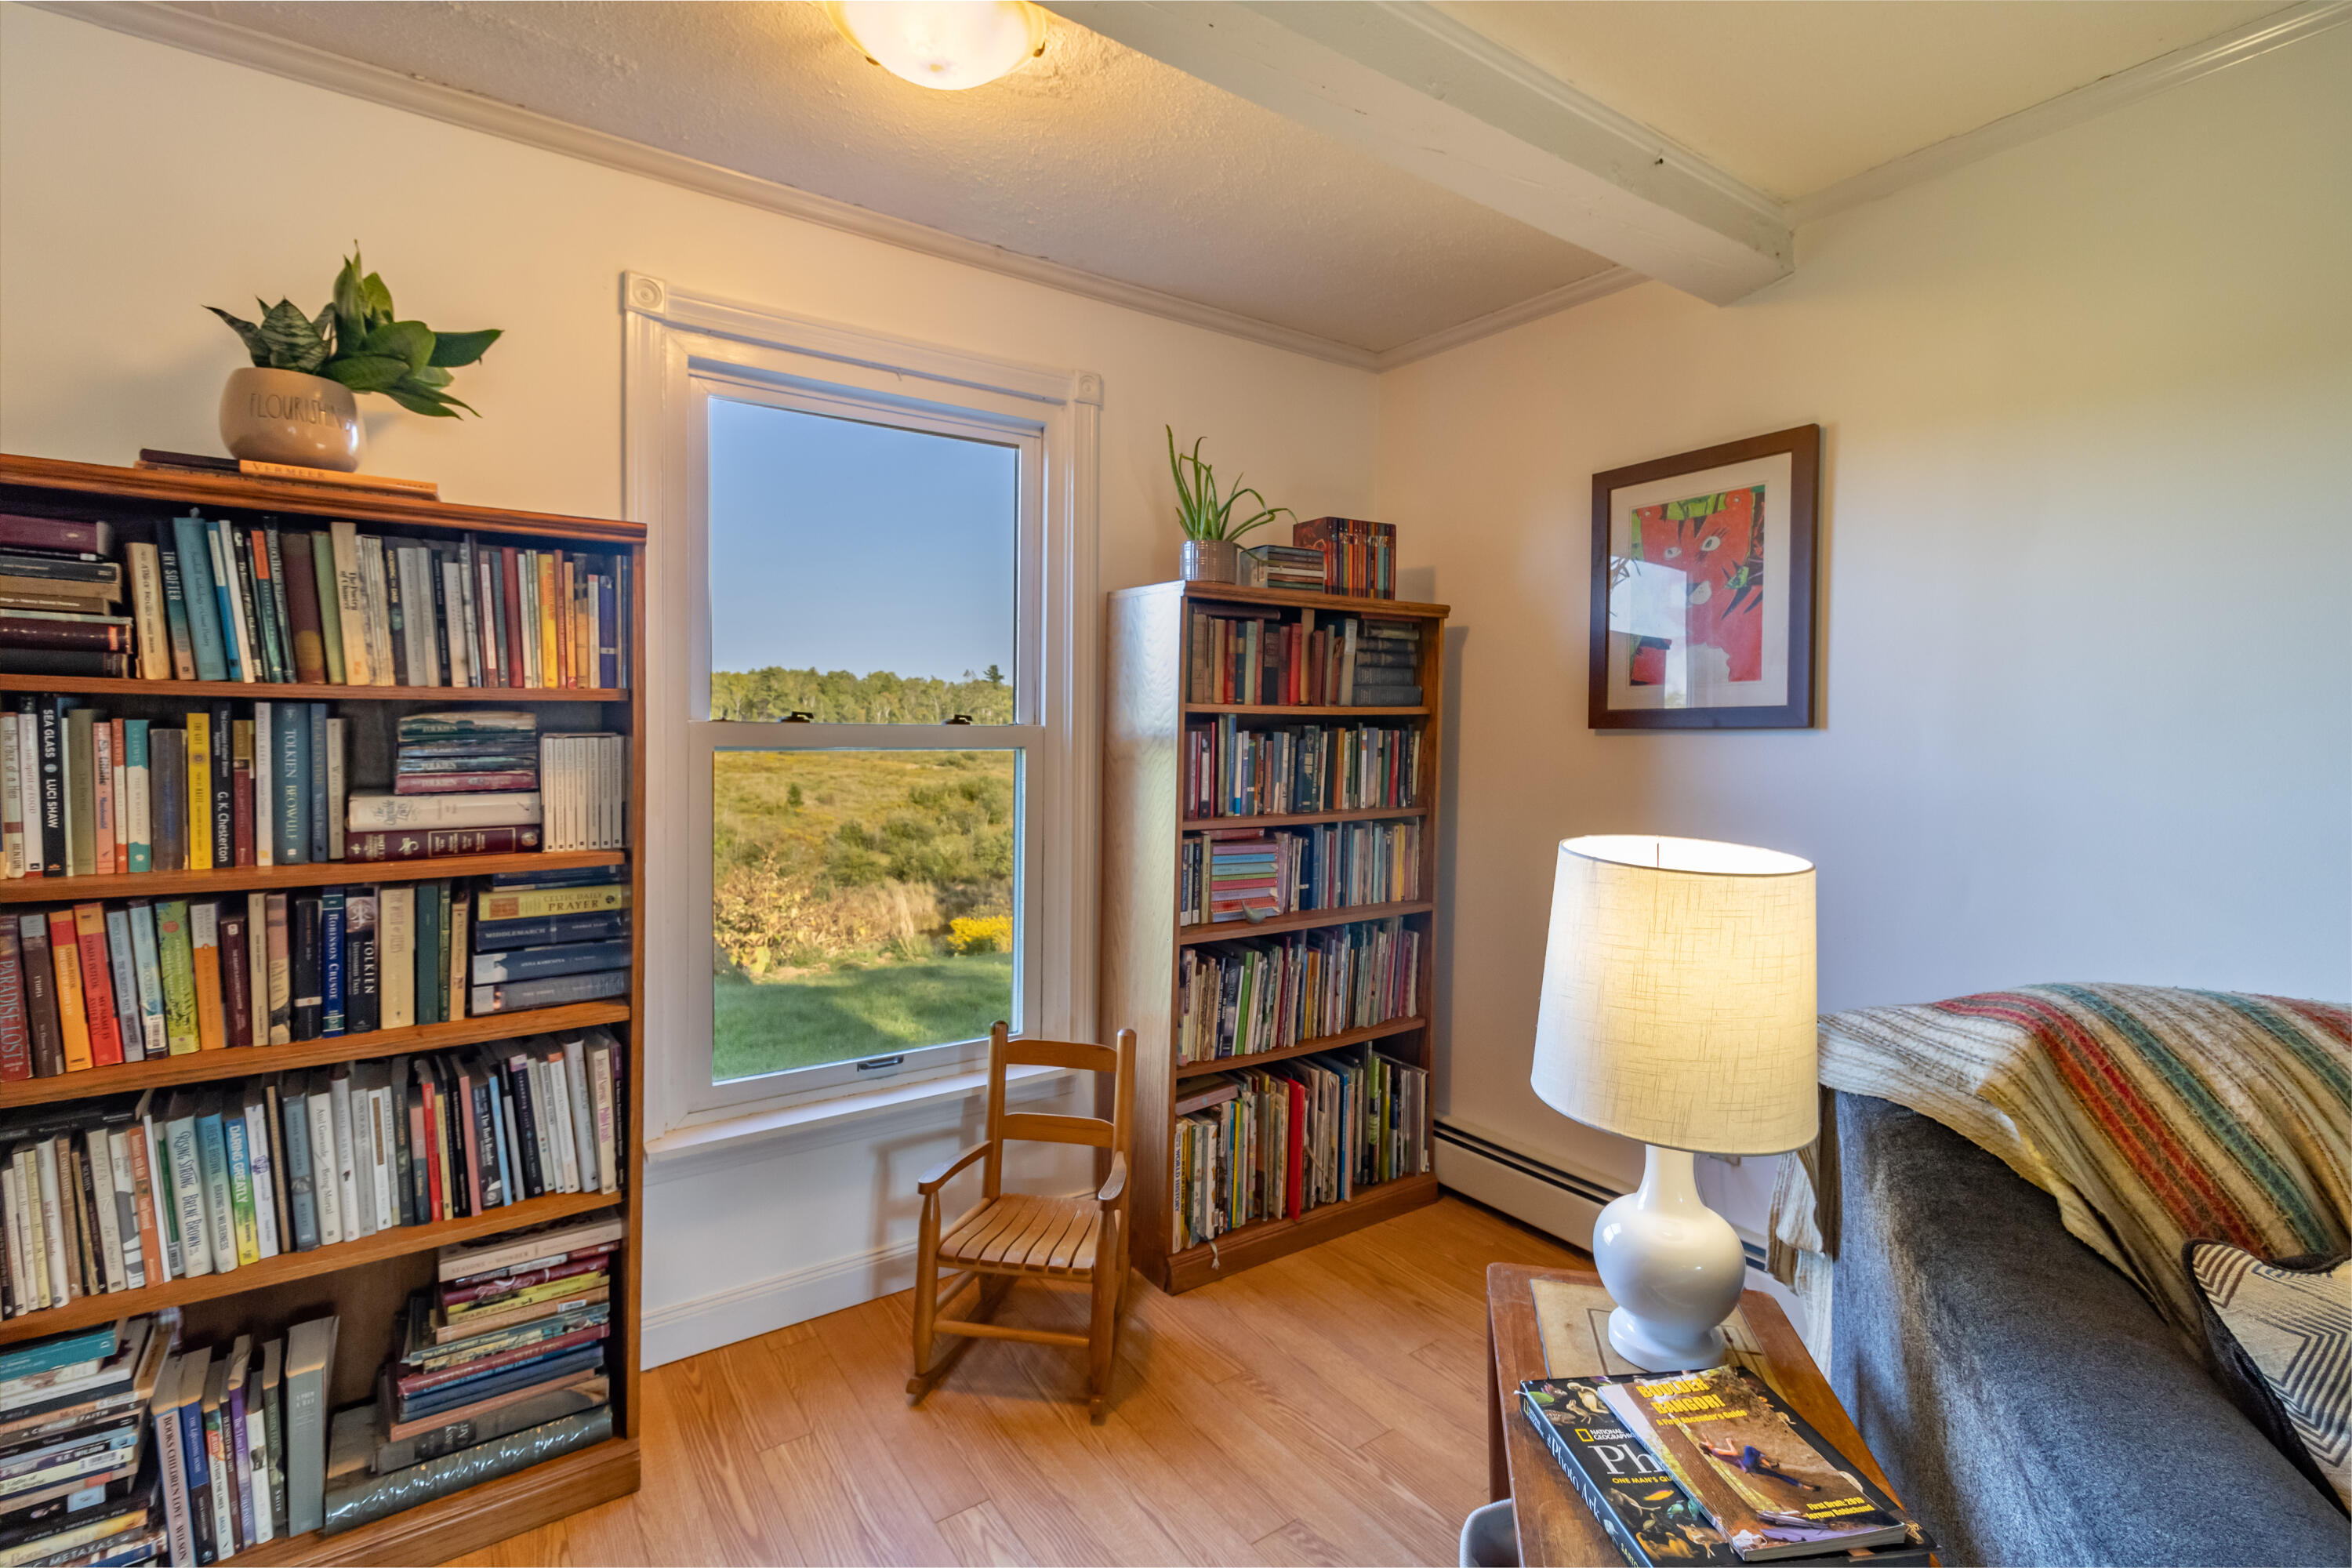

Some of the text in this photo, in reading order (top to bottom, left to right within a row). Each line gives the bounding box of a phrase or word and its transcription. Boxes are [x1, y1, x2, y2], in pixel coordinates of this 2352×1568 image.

[162, 552, 180, 601] TRY SOFTER
[342, 580, 350, 610] Chaucer
[348, 572, 359, 611] The Poetry
[42, 710, 56, 757] SEA GLASS
[132, 739, 140, 762] LEWIS
[421, 761, 456, 770] TOLKIEN
[8, 786, 19, 799] Hen
[284, 728, 297, 840] TOLKIEN BEOWULF
[46, 779, 58, 828] LUCI SHAW
[217, 791, 229, 862] G. K. Chesterton
[314, 822, 322, 840] Berry
[12, 843, 22, 869] BENTON
[543, 895, 574, 903] CELTIC
[548, 900, 599, 912] PRAYER
[485, 928, 546, 938] MIDDLEMARCH
[59, 962, 67, 976] GIFT
[328, 913, 339, 1000] ROBINSON CRUSOE
[364, 941, 375, 995] TOLKIEN
[34, 975, 43, 998] UTOPIA
[88, 964, 98, 989] POTOK
[60, 986, 71, 1004] ASHER
[98, 996, 106, 1007] MY
[0, 960, 24, 1060] PARADISE LOST
[88, 997, 100, 1036] ASHER LEV
[99, 1010, 107, 1029] NAME
[318, 1126, 328, 1157] Gawande
[93, 1151, 107, 1181] SEVEN
[210, 1148, 221, 1174] BROWN
[229, 1125, 248, 1203] DARING GREATLY
[485, 1145, 494, 1166] Reader
[173, 1131, 202, 1248] RISING STRONG BRENÉ BROWN
[320, 1167, 330, 1189] Being
[324, 1190, 333, 1215] Mortal
[213, 1184, 229, 1250] BRAVING WILDERNESS
[1636, 1378, 1711, 1398] BOULDER
[79, 1410, 109, 1421] FAITH
[1650, 1394, 1726, 1414] BANGOR!
[1722, 1410, 1748, 1419] Guide
[223, 1416, 231, 1444] BLESSED
[1587, 1444, 1664, 1475] Ph
[163, 1416, 188, 1561] BOOKS CHILDREN LOVE WILSON
[1552, 1436, 1601, 1523] Photo Ark
[1844, 1497, 1865, 1505] 2010
[1806, 1511, 1836, 1519] Jeremy
[49, 1541, 114, 1566] METAXAS
[1621, 1543, 1639, 1567] SARTO
